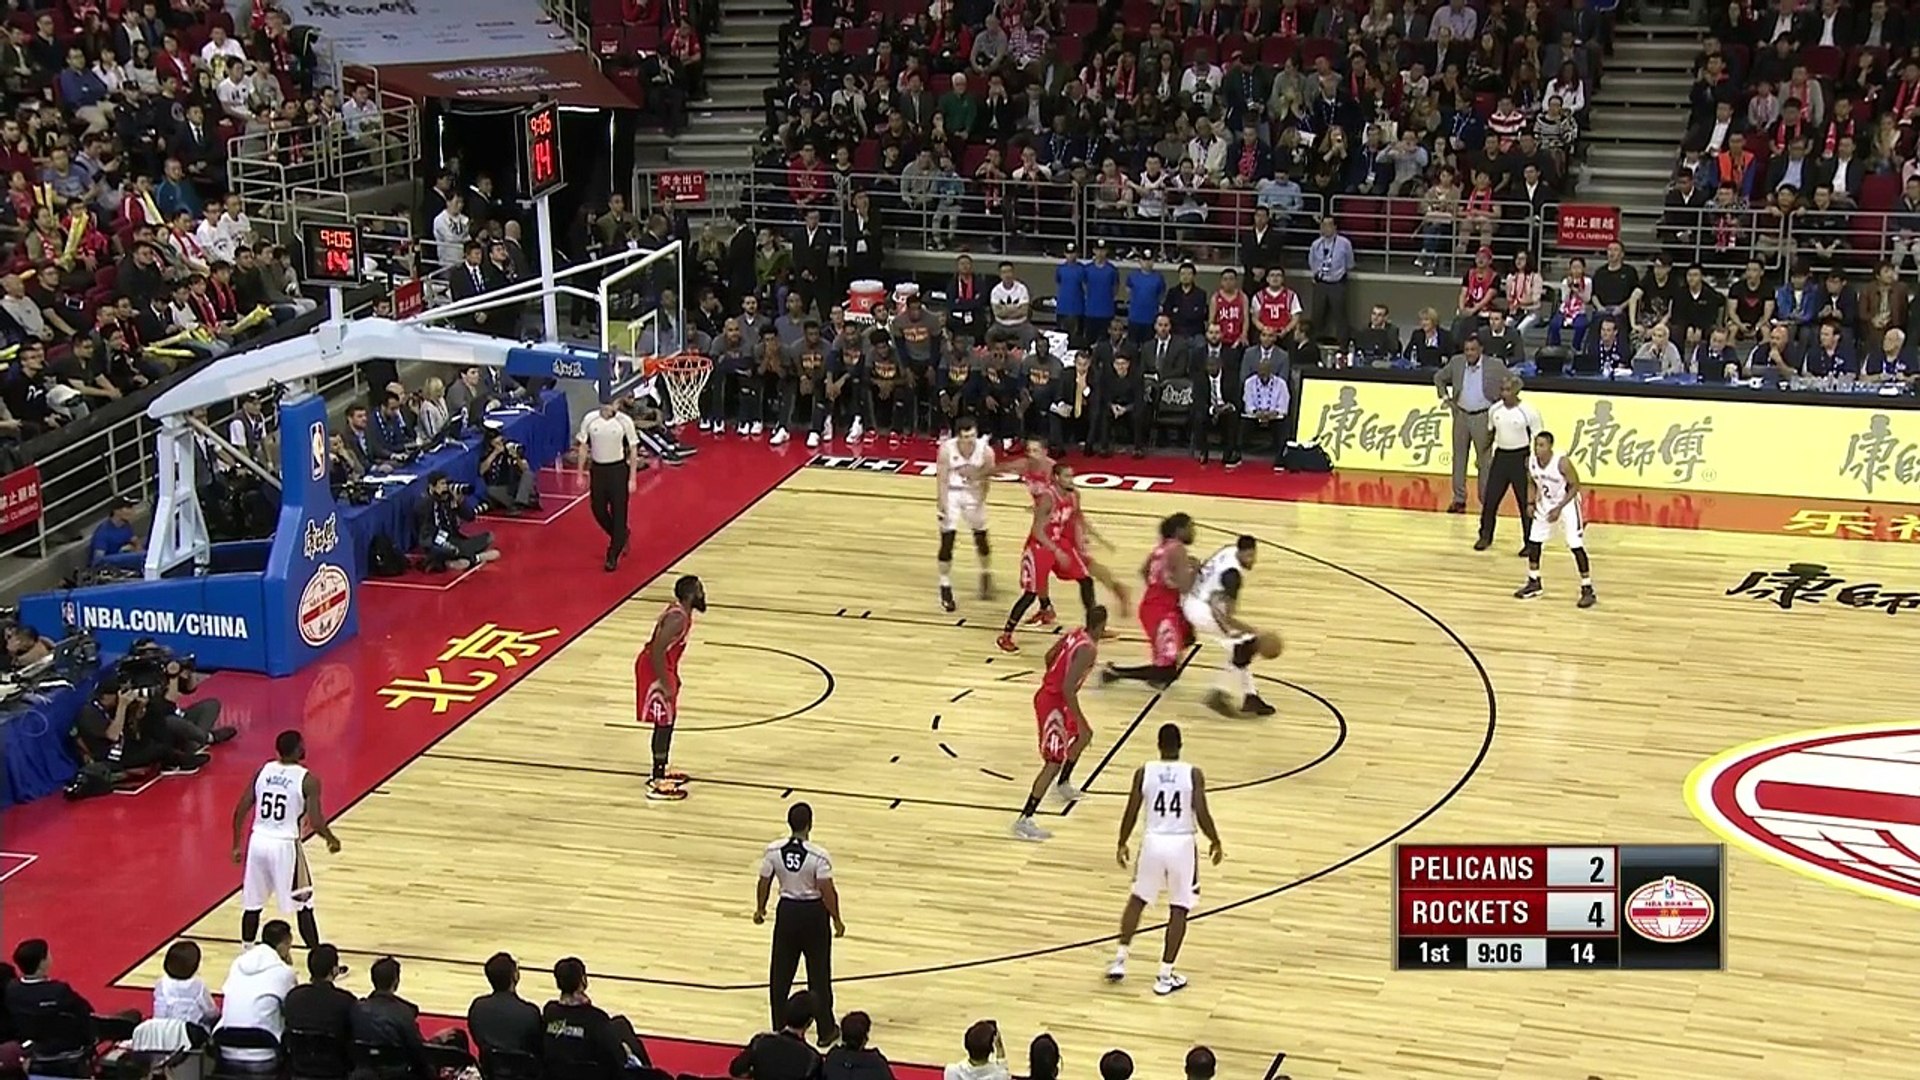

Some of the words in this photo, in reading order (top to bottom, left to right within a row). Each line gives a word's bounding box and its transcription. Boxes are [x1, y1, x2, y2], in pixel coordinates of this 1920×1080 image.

[531, 110, 551, 136] 9:06
[535, 139, 551, 180] 14
[320, 229, 352, 249] 9:06
[1542, 484, 1552, 499] 2
[83, 606, 248, 639] NBA.COM/CHINA
[261, 792, 287, 821] 55
[1154, 790, 1182, 818] 44
[786, 853, 801, 869] 55
